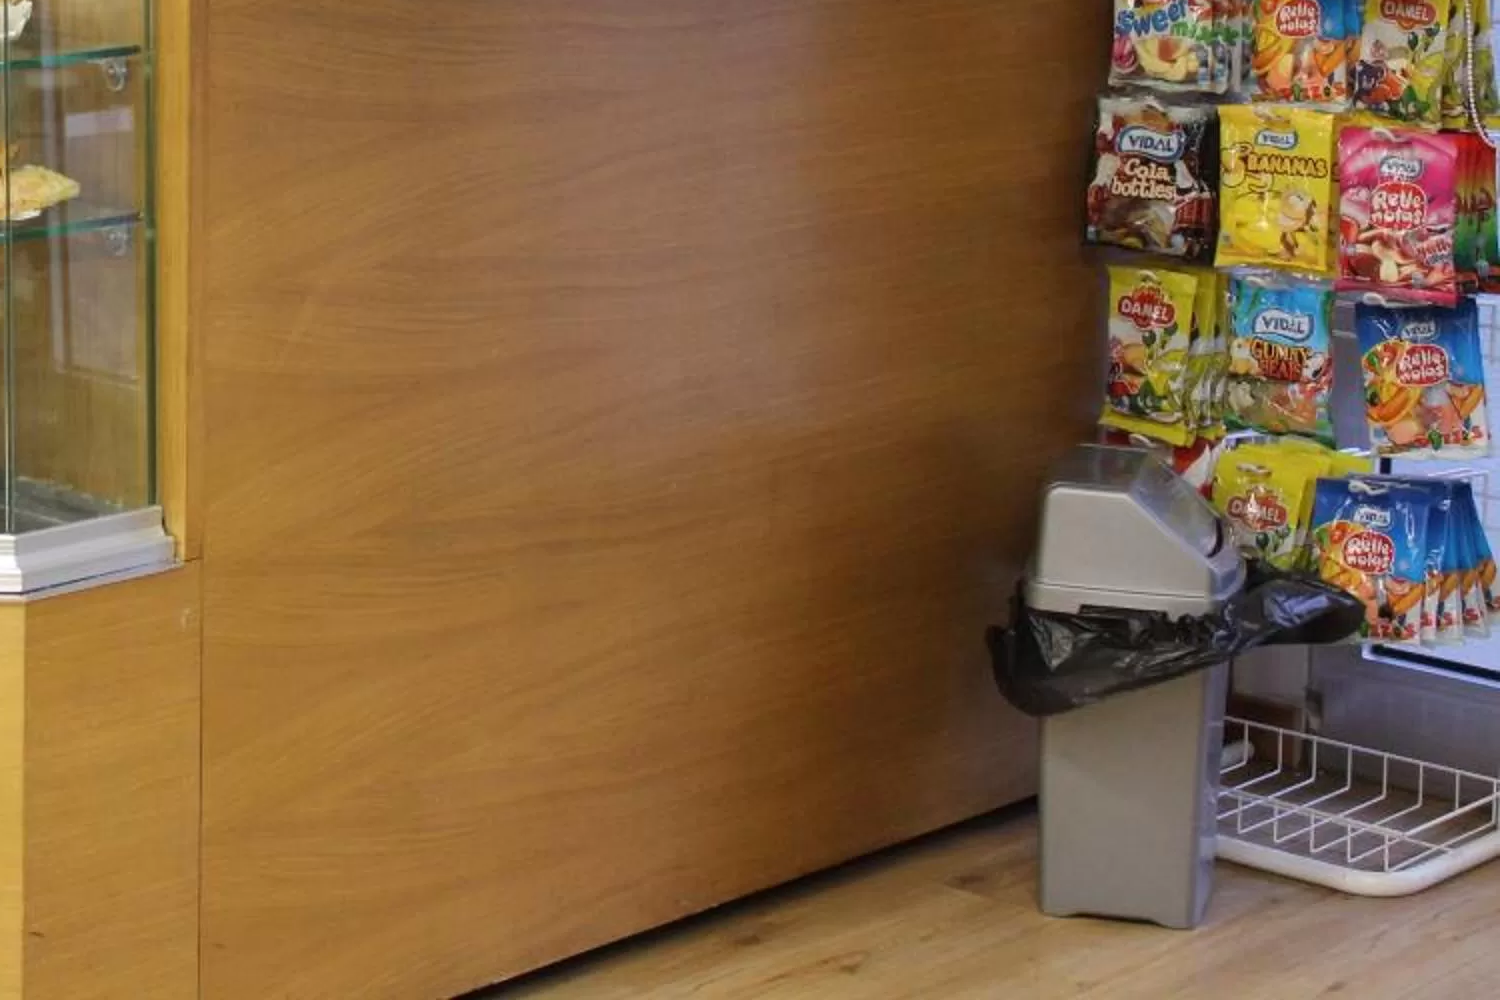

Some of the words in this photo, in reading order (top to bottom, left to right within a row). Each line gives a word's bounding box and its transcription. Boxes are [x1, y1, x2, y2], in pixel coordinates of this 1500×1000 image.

[1128, 135, 1174, 152] VIDAL
[1124, 158, 1170, 181] Cola
[1248, 153, 1328, 178] BANANAS
[1112, 179, 1175, 200] bottles
[1120, 300, 1169, 322] DAMEL
